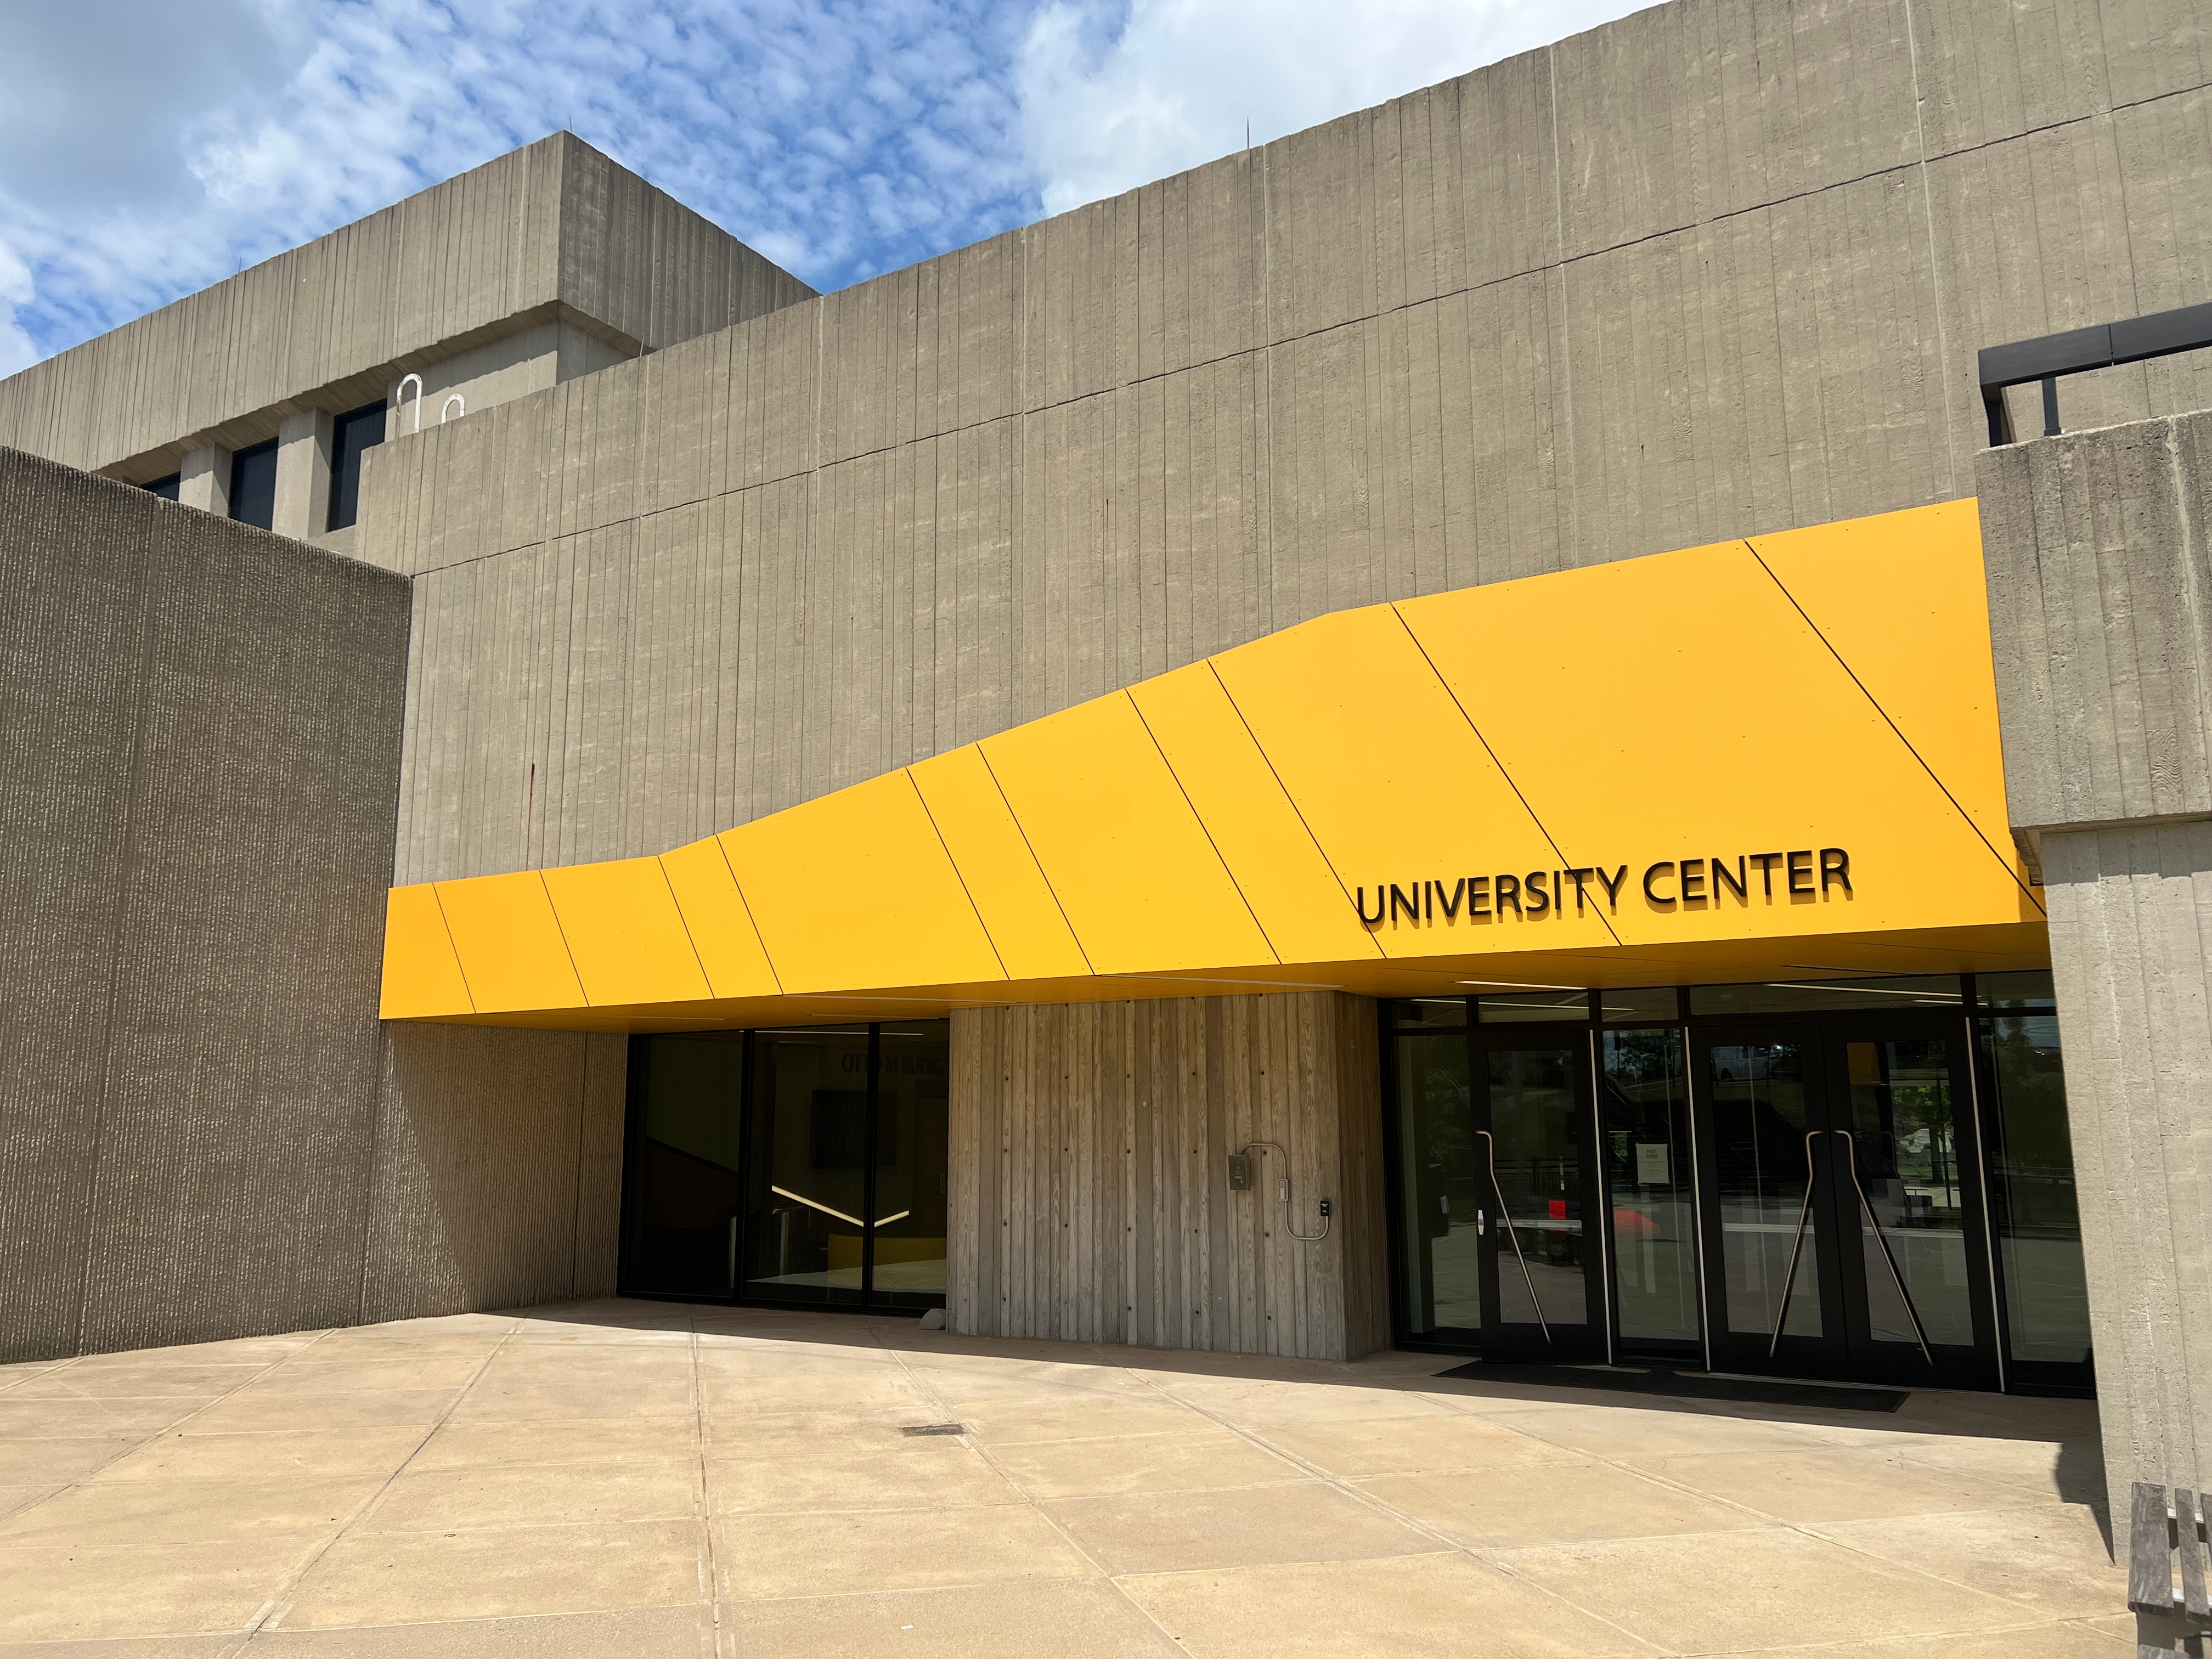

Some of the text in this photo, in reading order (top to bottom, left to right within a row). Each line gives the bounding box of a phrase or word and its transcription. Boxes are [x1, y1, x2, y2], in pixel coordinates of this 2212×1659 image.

[1356, 848, 1853, 924] UNIVERSITY CENTER
[841, 1053, 883, 1073] OTT
